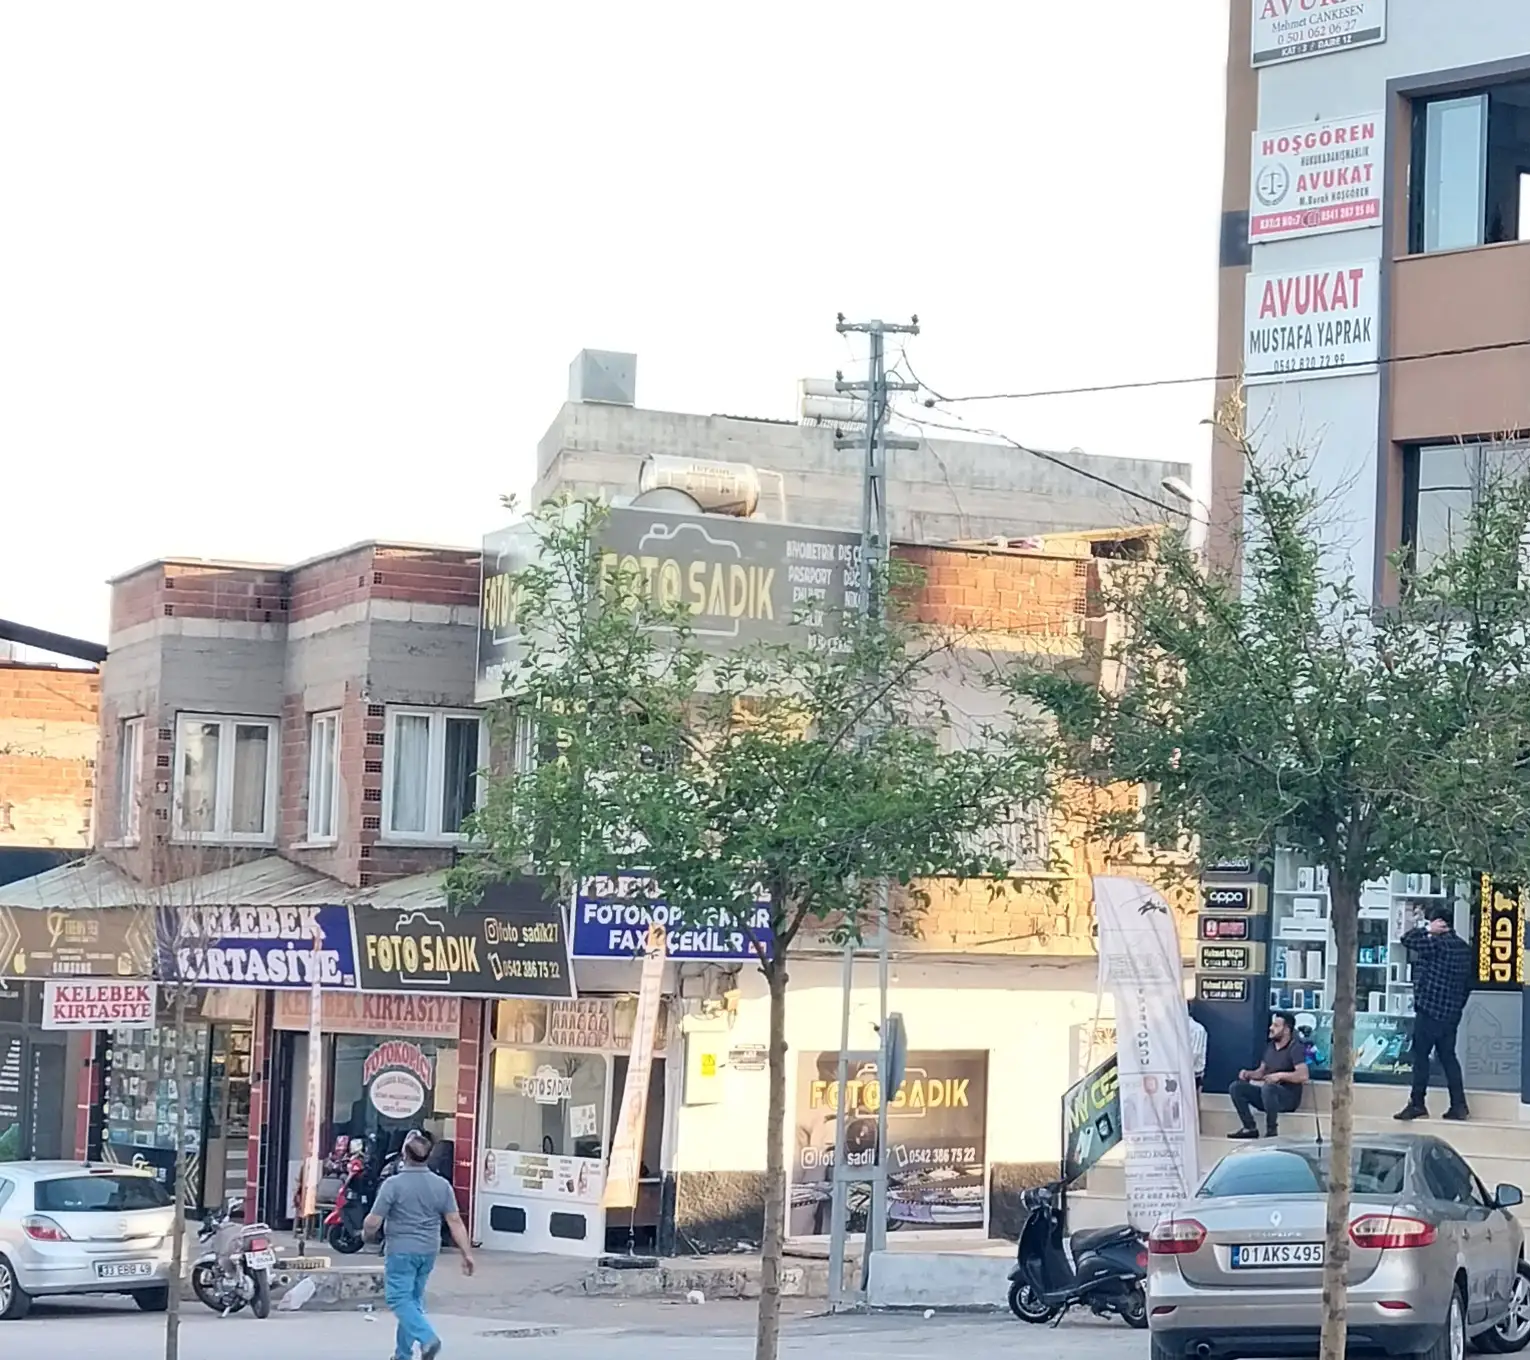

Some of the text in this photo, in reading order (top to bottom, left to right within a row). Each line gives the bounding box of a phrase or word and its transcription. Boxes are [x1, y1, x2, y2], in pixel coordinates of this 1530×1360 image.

[1271, 3, 1365, 34] Mehmet CANKESEN
[1287, 30, 1305, 44] 501
[1344, 18, 1358, 31] 27
[1261, 122, 1375, 156] HOŞGÖREN
[1296, 162, 1374, 193] AVUKAT
[1259, 268, 1364, 320] AVUKAT
[1250, 317, 1372, 354] MUSTAFA YAPRAK
[599, 553, 776, 621] FOTO SADIK
[175, 906, 326, 940] KELEBEK
[583, 904, 687, 927] FOTOKOP
[173, 941, 343, 984] KIRTASİYE
[365, 935, 481, 973] FOTO SADIK
[54, 984, 150, 1003] KELEBEK
[361, 994, 459, 1023] KIRTASİYE
[53, 1003, 151, 1020] KIRTASİYE
[522, 1078, 573, 1099] FOTO SADIK
[909, 1149, 932, 1165] 0542
[932, 1149, 950, 1164] 386
[950, 1148, 962, 1162] 75
[962, 1147, 976, 1162] 22
[1241, 1245, 1321, 1263] 01 AKS 495
